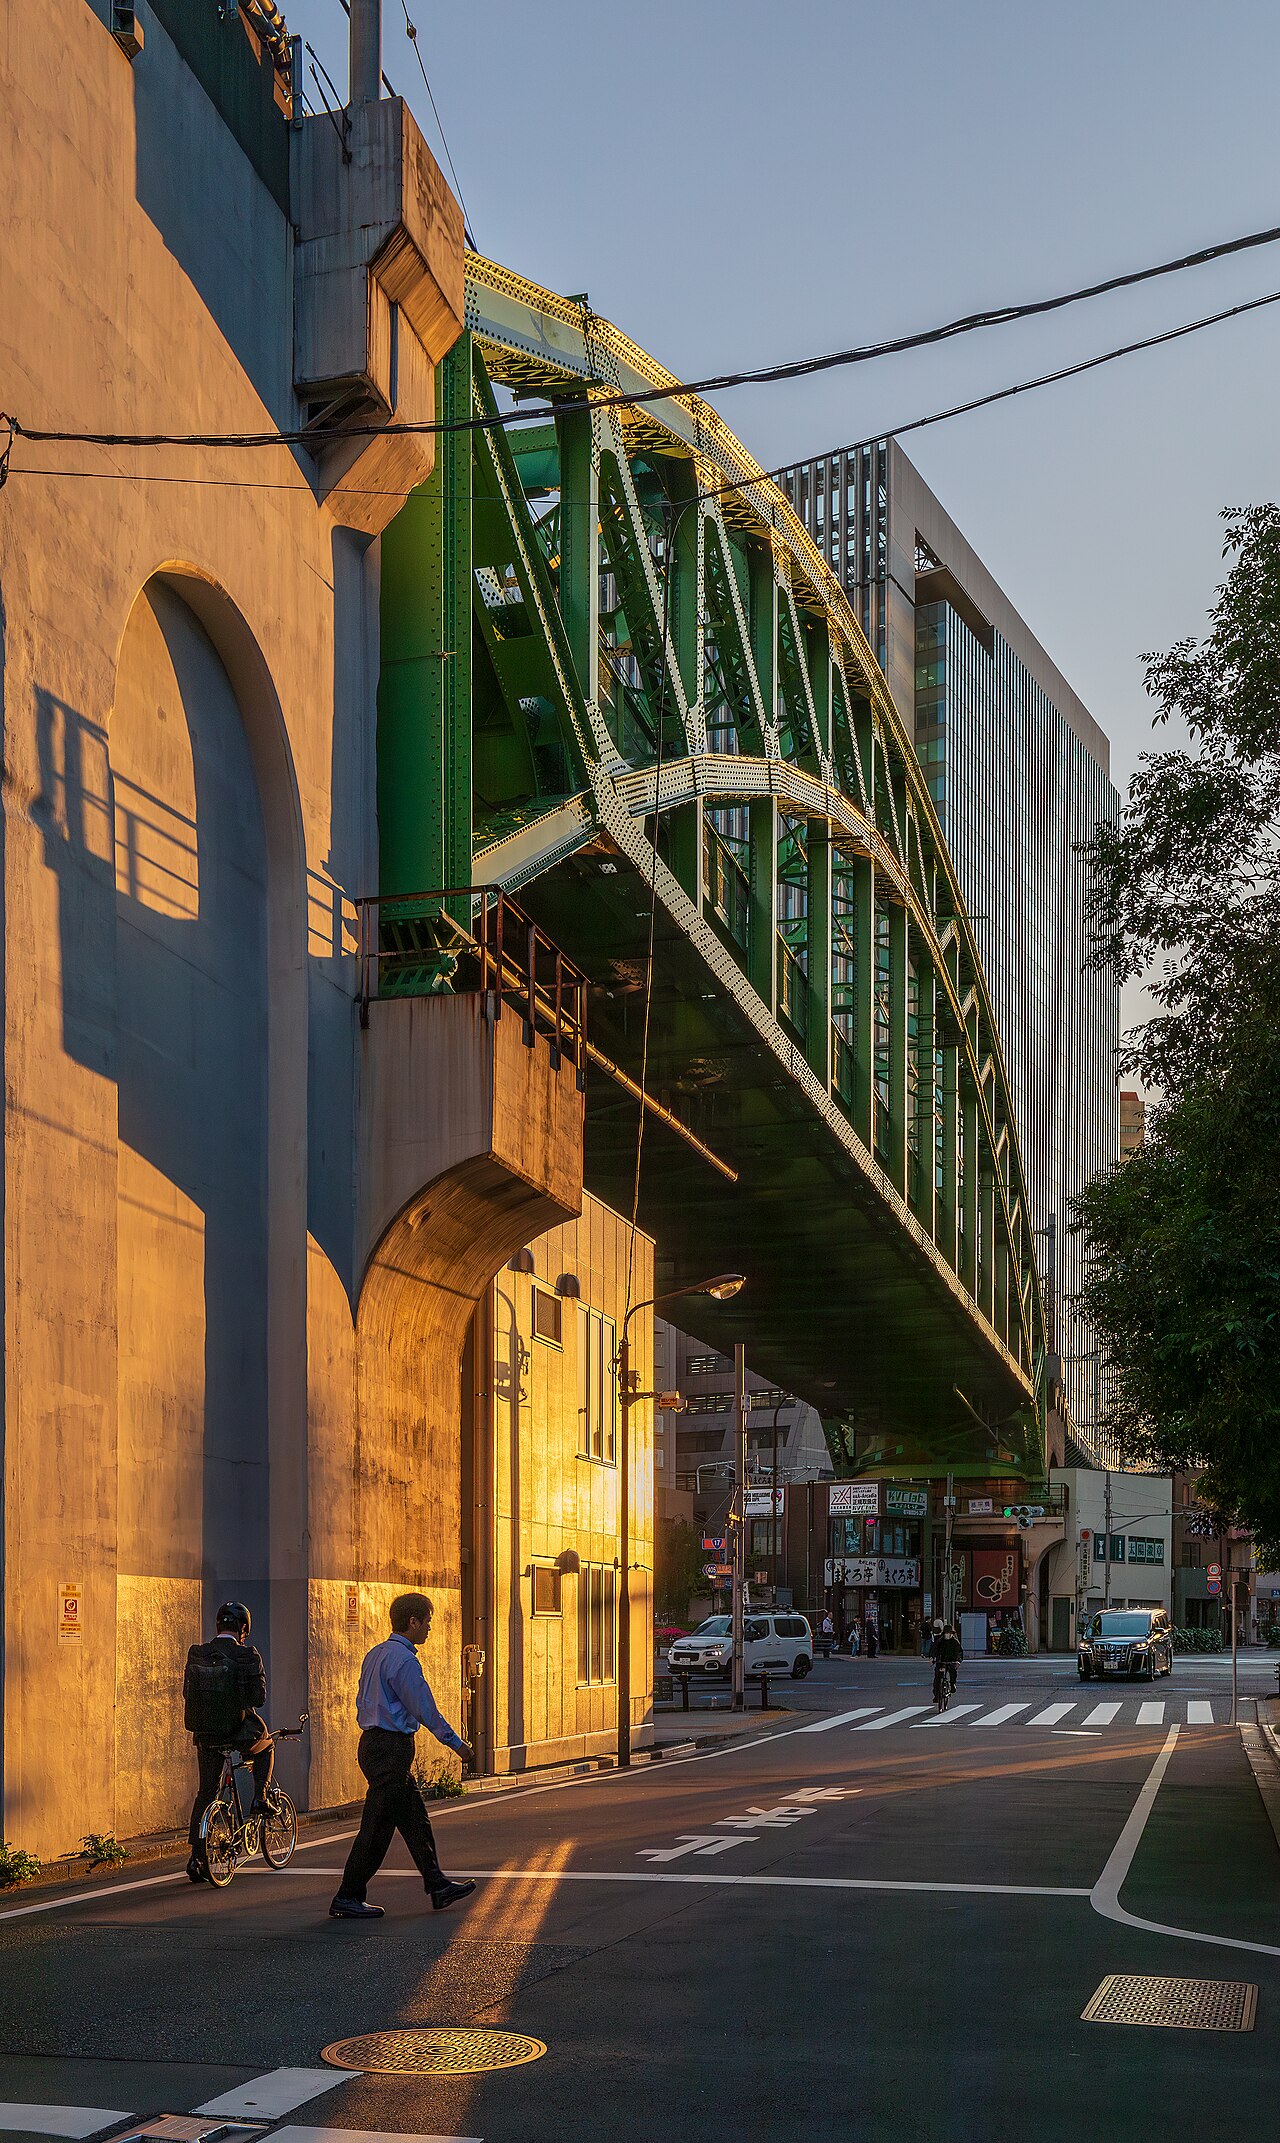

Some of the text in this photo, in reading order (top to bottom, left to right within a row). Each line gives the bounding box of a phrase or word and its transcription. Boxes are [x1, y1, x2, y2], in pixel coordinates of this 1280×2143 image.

[834, 1567, 874, 1585] まぐろ亭
[884, 1568, 915, 1585] まぐろ亭
